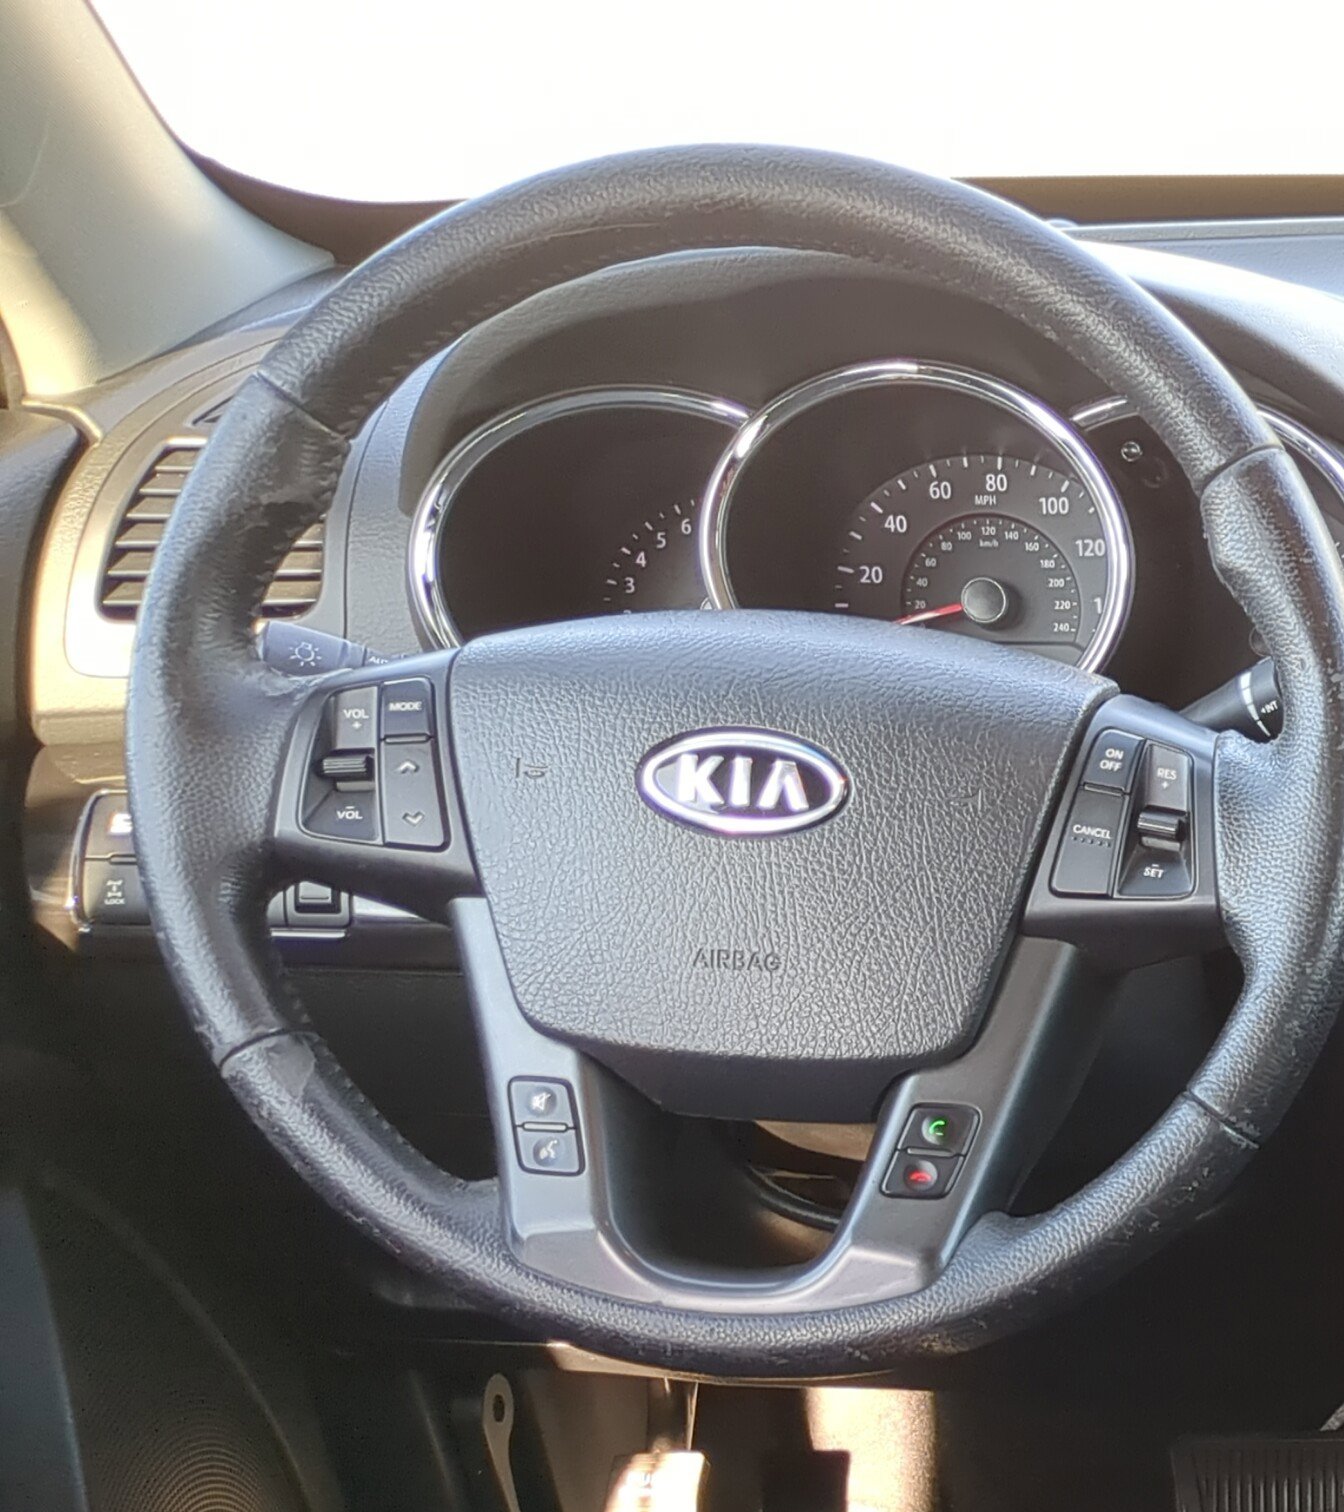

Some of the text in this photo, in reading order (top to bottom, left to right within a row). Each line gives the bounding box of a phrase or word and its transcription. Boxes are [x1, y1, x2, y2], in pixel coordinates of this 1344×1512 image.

[985, 474, 1008, 492] 80
[929, 482, 952, 500] 60
[975, 495, 997, 506] MPH
[1039, 497, 1069, 515] 100
[681, 518, 692, 535] 6
[884, 515, 907, 533] 40
[958, 531, 972, 540] 100
[981, 526, 996, 536] 120
[1004, 531, 1019, 540] 140
[656, 532, 667, 549] 5
[979, 539, 999, 548] km/h
[941, 542, 952, 551] 80
[1025, 542, 1040, 552] 160
[1075, 538, 1106, 557] 120
[635, 551, 647, 567] 4
[925, 558, 937, 567] 60
[1040, 559, 1055, 569] 180
[860, 566, 883, 584] 20
[624, 577, 635, 593] 3
[916, 578, 928, 588] 40
[1048, 578, 1065, 588] 200
[914, 600, 926, 609] 20
[1054, 600, 1071, 610] 220
[1053, 623, 1070, 632] 240
[389, 701, 422, 711] MODE
[343, 709, 369, 719] VOL
[1105, 748, 1123, 760] ON
[1100, 760, 1122, 772] OFF
[1157, 768, 1177, 780] RES
[676, 753, 810, 812] KIA
[337, 811, 363, 820] VOL
[1072, 824, 1111, 840] CANCEL
[1143, 867, 1164, 879] SET
[692, 948, 782, 971] AIRBAG
